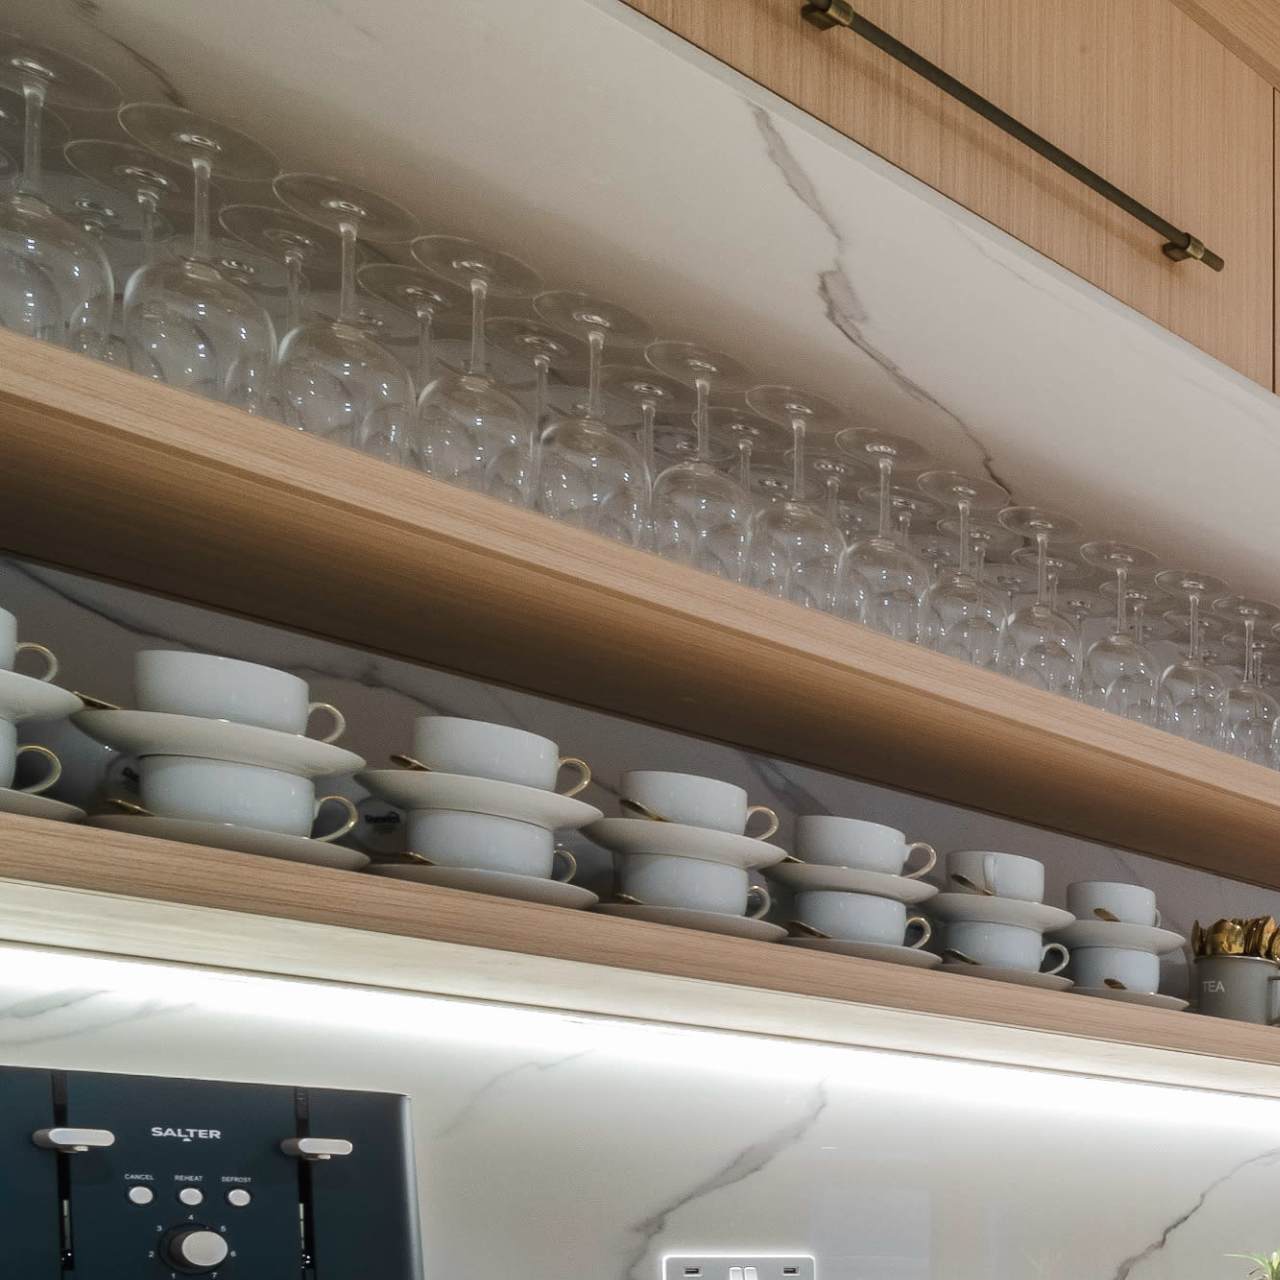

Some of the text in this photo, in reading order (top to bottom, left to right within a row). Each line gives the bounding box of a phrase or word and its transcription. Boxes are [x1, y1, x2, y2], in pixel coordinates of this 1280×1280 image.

[1202, 980, 1225, 992] TEA
[151, 1127, 221, 1139] SALTER
[148, 1250, 154, 1258] 2
